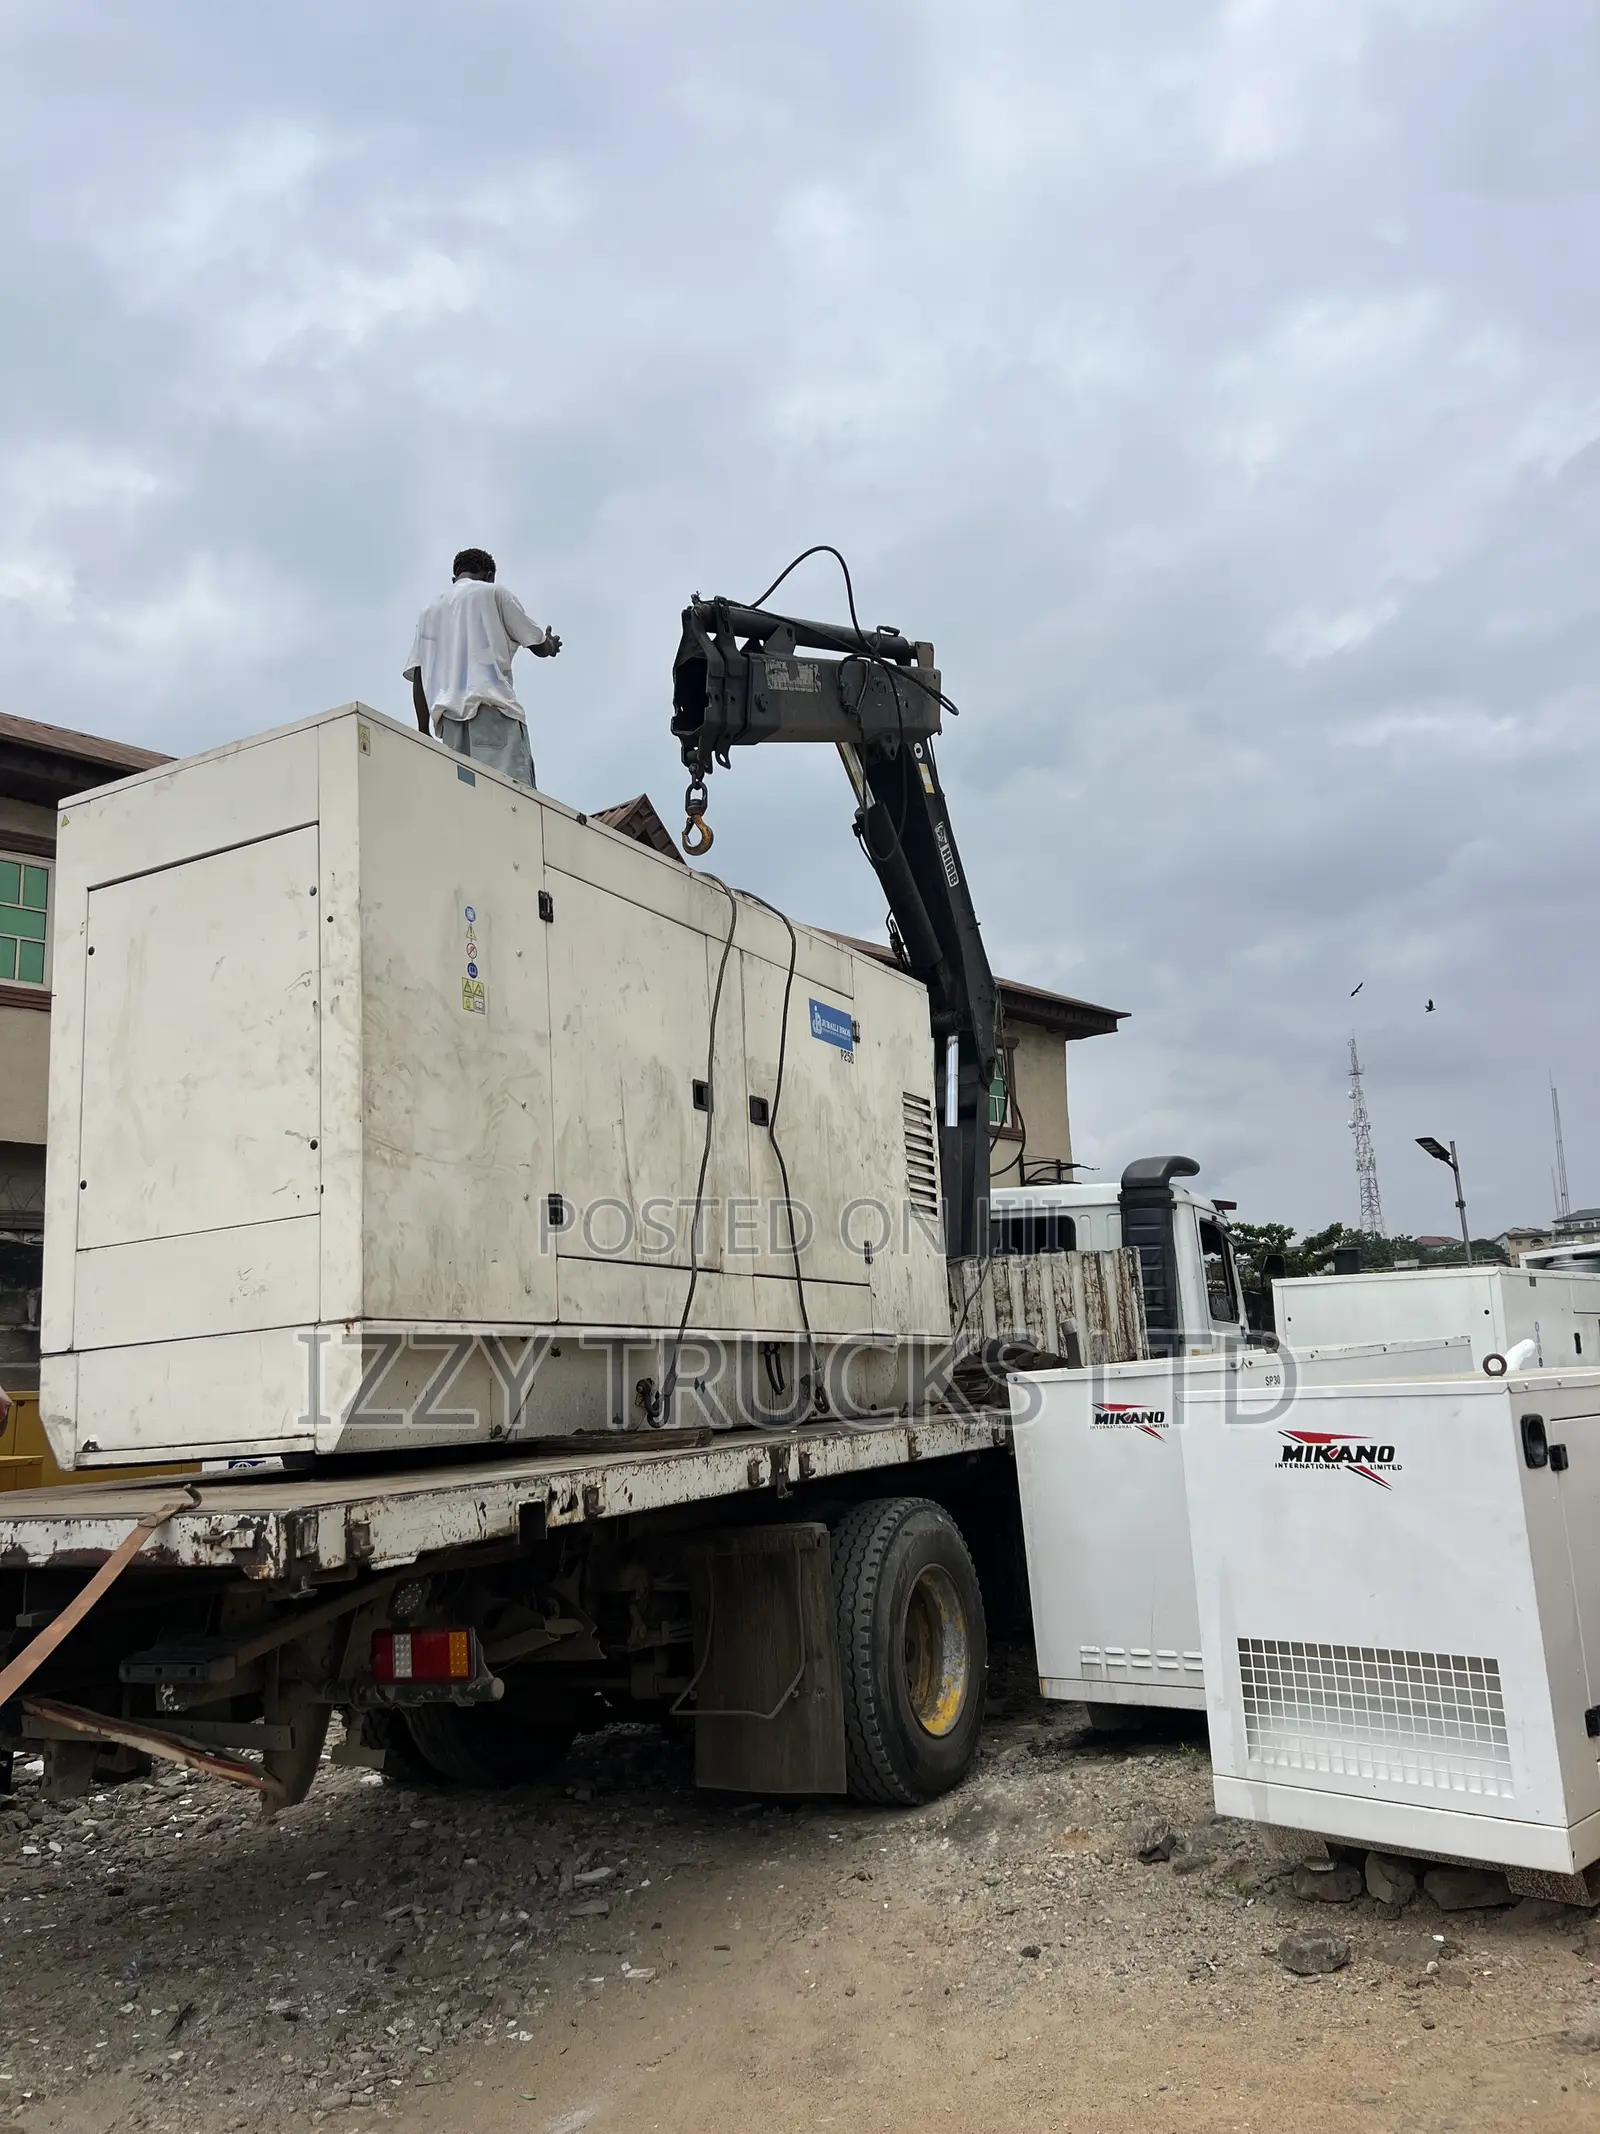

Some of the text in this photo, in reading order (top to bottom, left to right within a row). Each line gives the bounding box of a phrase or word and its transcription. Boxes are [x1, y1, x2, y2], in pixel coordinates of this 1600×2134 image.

[941, 846, 959, 887] HIAB
[1265, 1374, 1281, 1386] SP30
[1095, 1411, 1165, 1425] MIKANO
[1282, 1445, 1396, 1463] MIKANO
[1275, 1462, 1341, 1470] INTERNATIONAL
